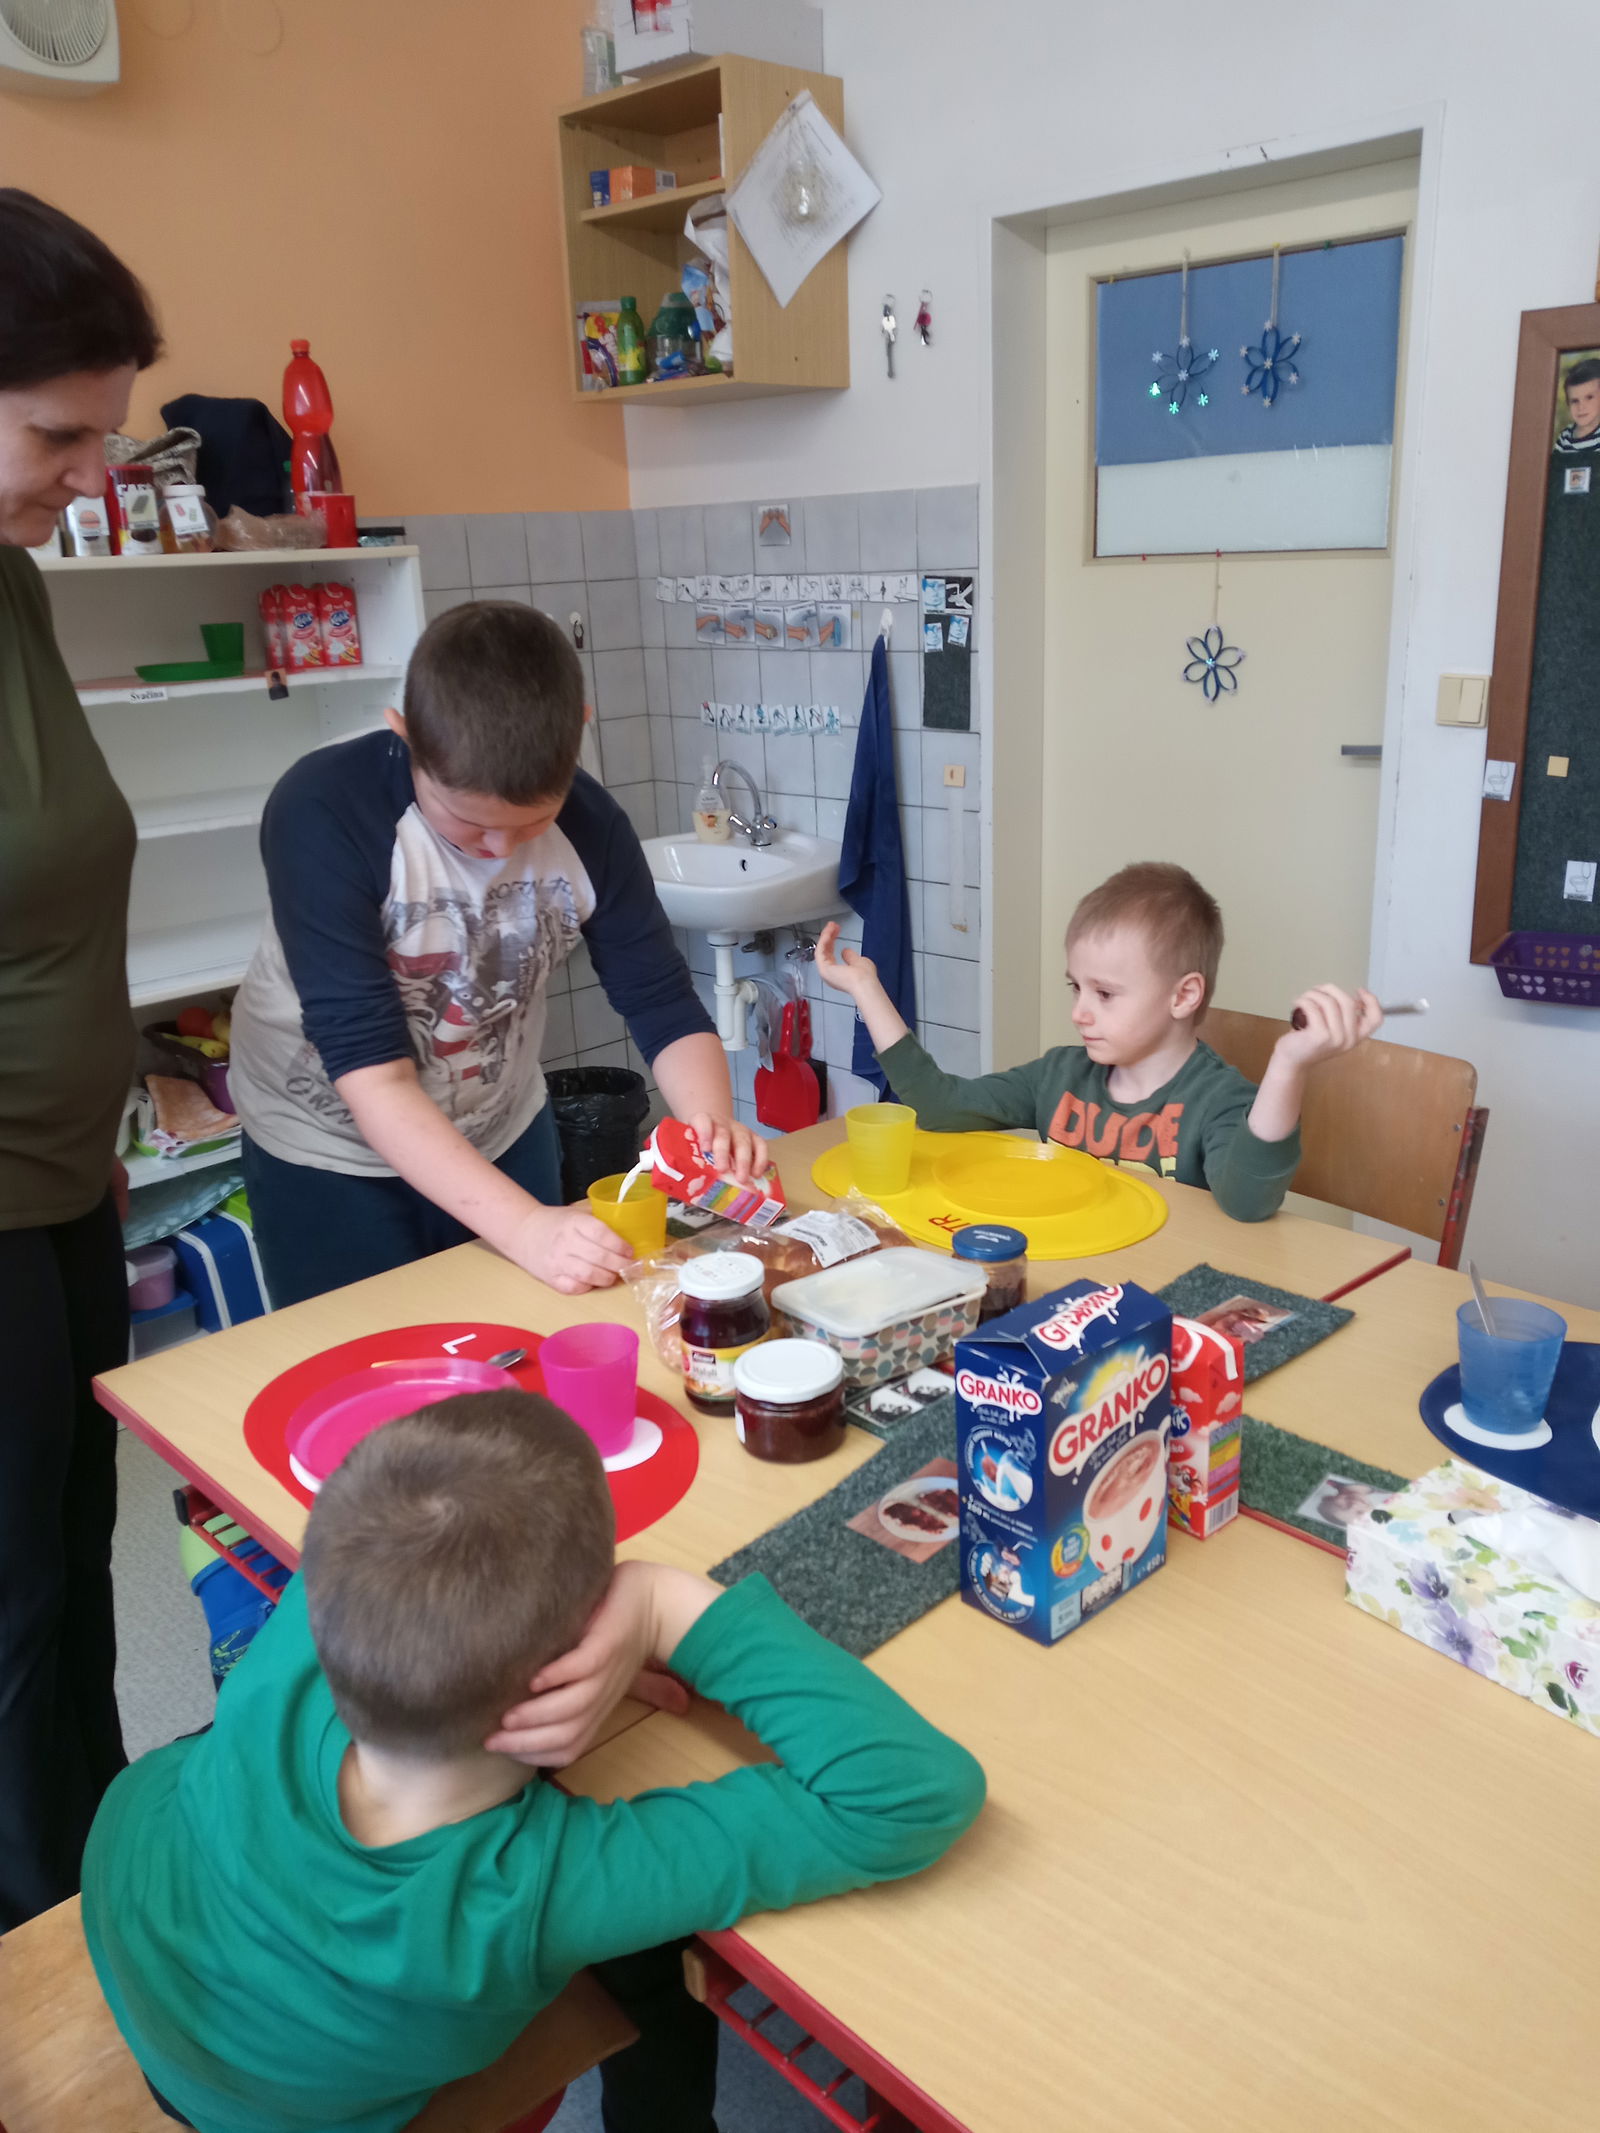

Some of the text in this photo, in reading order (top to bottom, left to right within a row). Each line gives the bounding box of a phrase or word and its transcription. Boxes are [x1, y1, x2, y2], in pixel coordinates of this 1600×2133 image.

[1047, 1090, 1186, 1161] DUDE
[960, 1374, 1040, 1411] GRANKO
[1053, 1359, 1167, 1465] GRANKO
